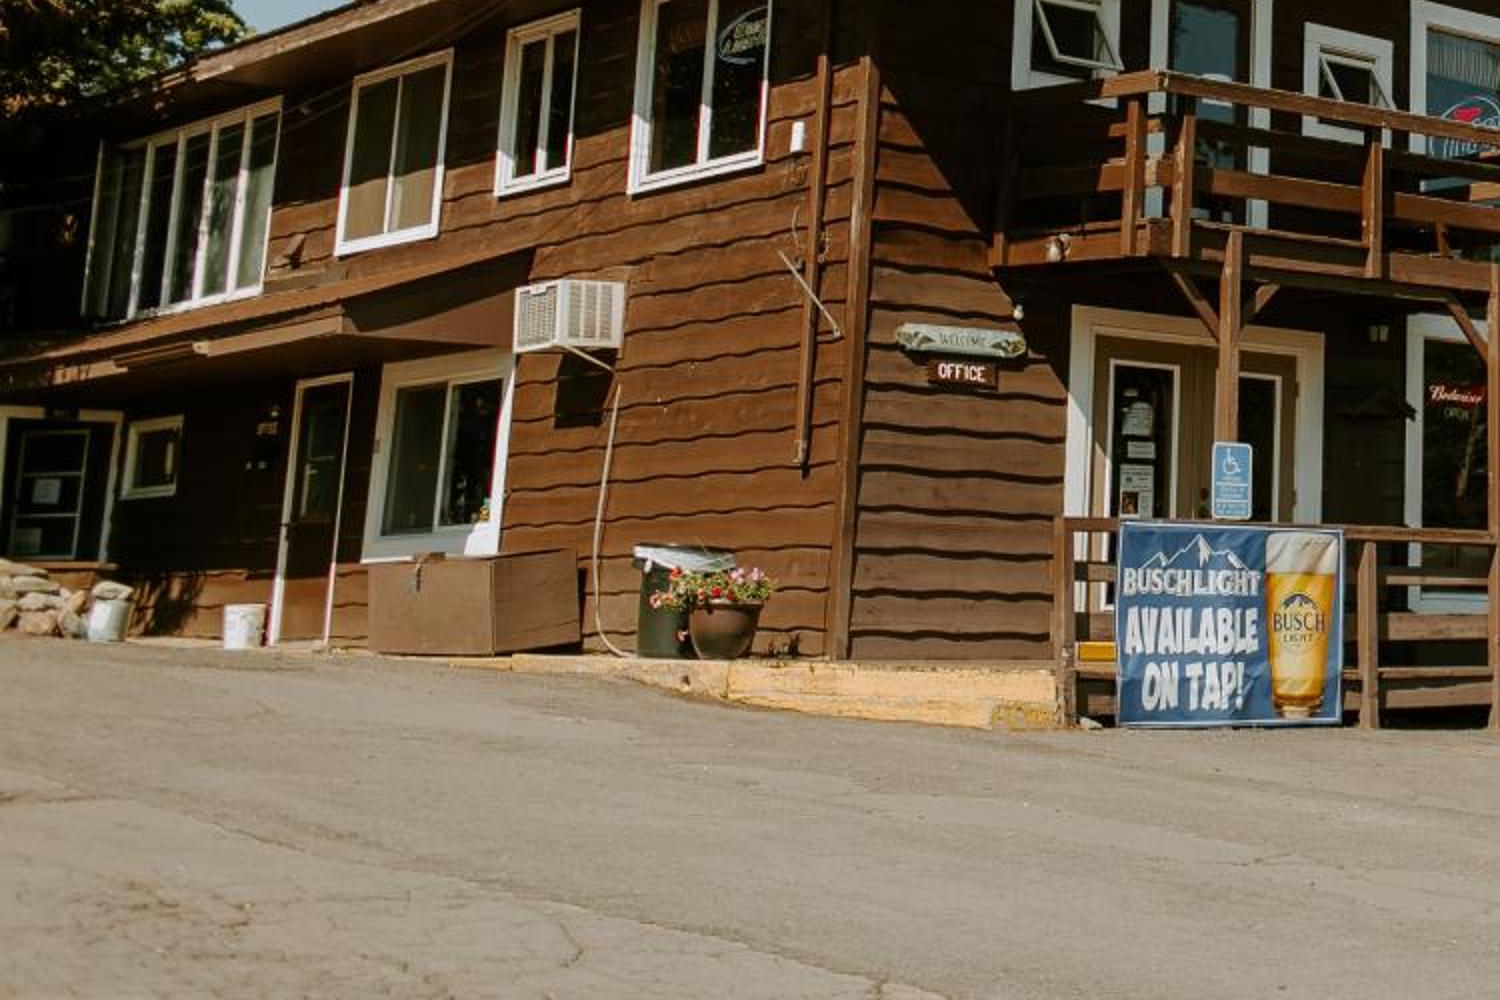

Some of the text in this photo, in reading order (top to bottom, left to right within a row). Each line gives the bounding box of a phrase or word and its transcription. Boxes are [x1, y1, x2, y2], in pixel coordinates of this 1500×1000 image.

[937, 363, 987, 382] OFFICE
[1124, 606, 1259, 654] AVAILABLE
[1273, 612, 1325, 633] BUSCH
[1283, 633, 1313, 643] LIGHT
[1142, 662, 1246, 711] ON TAP!
